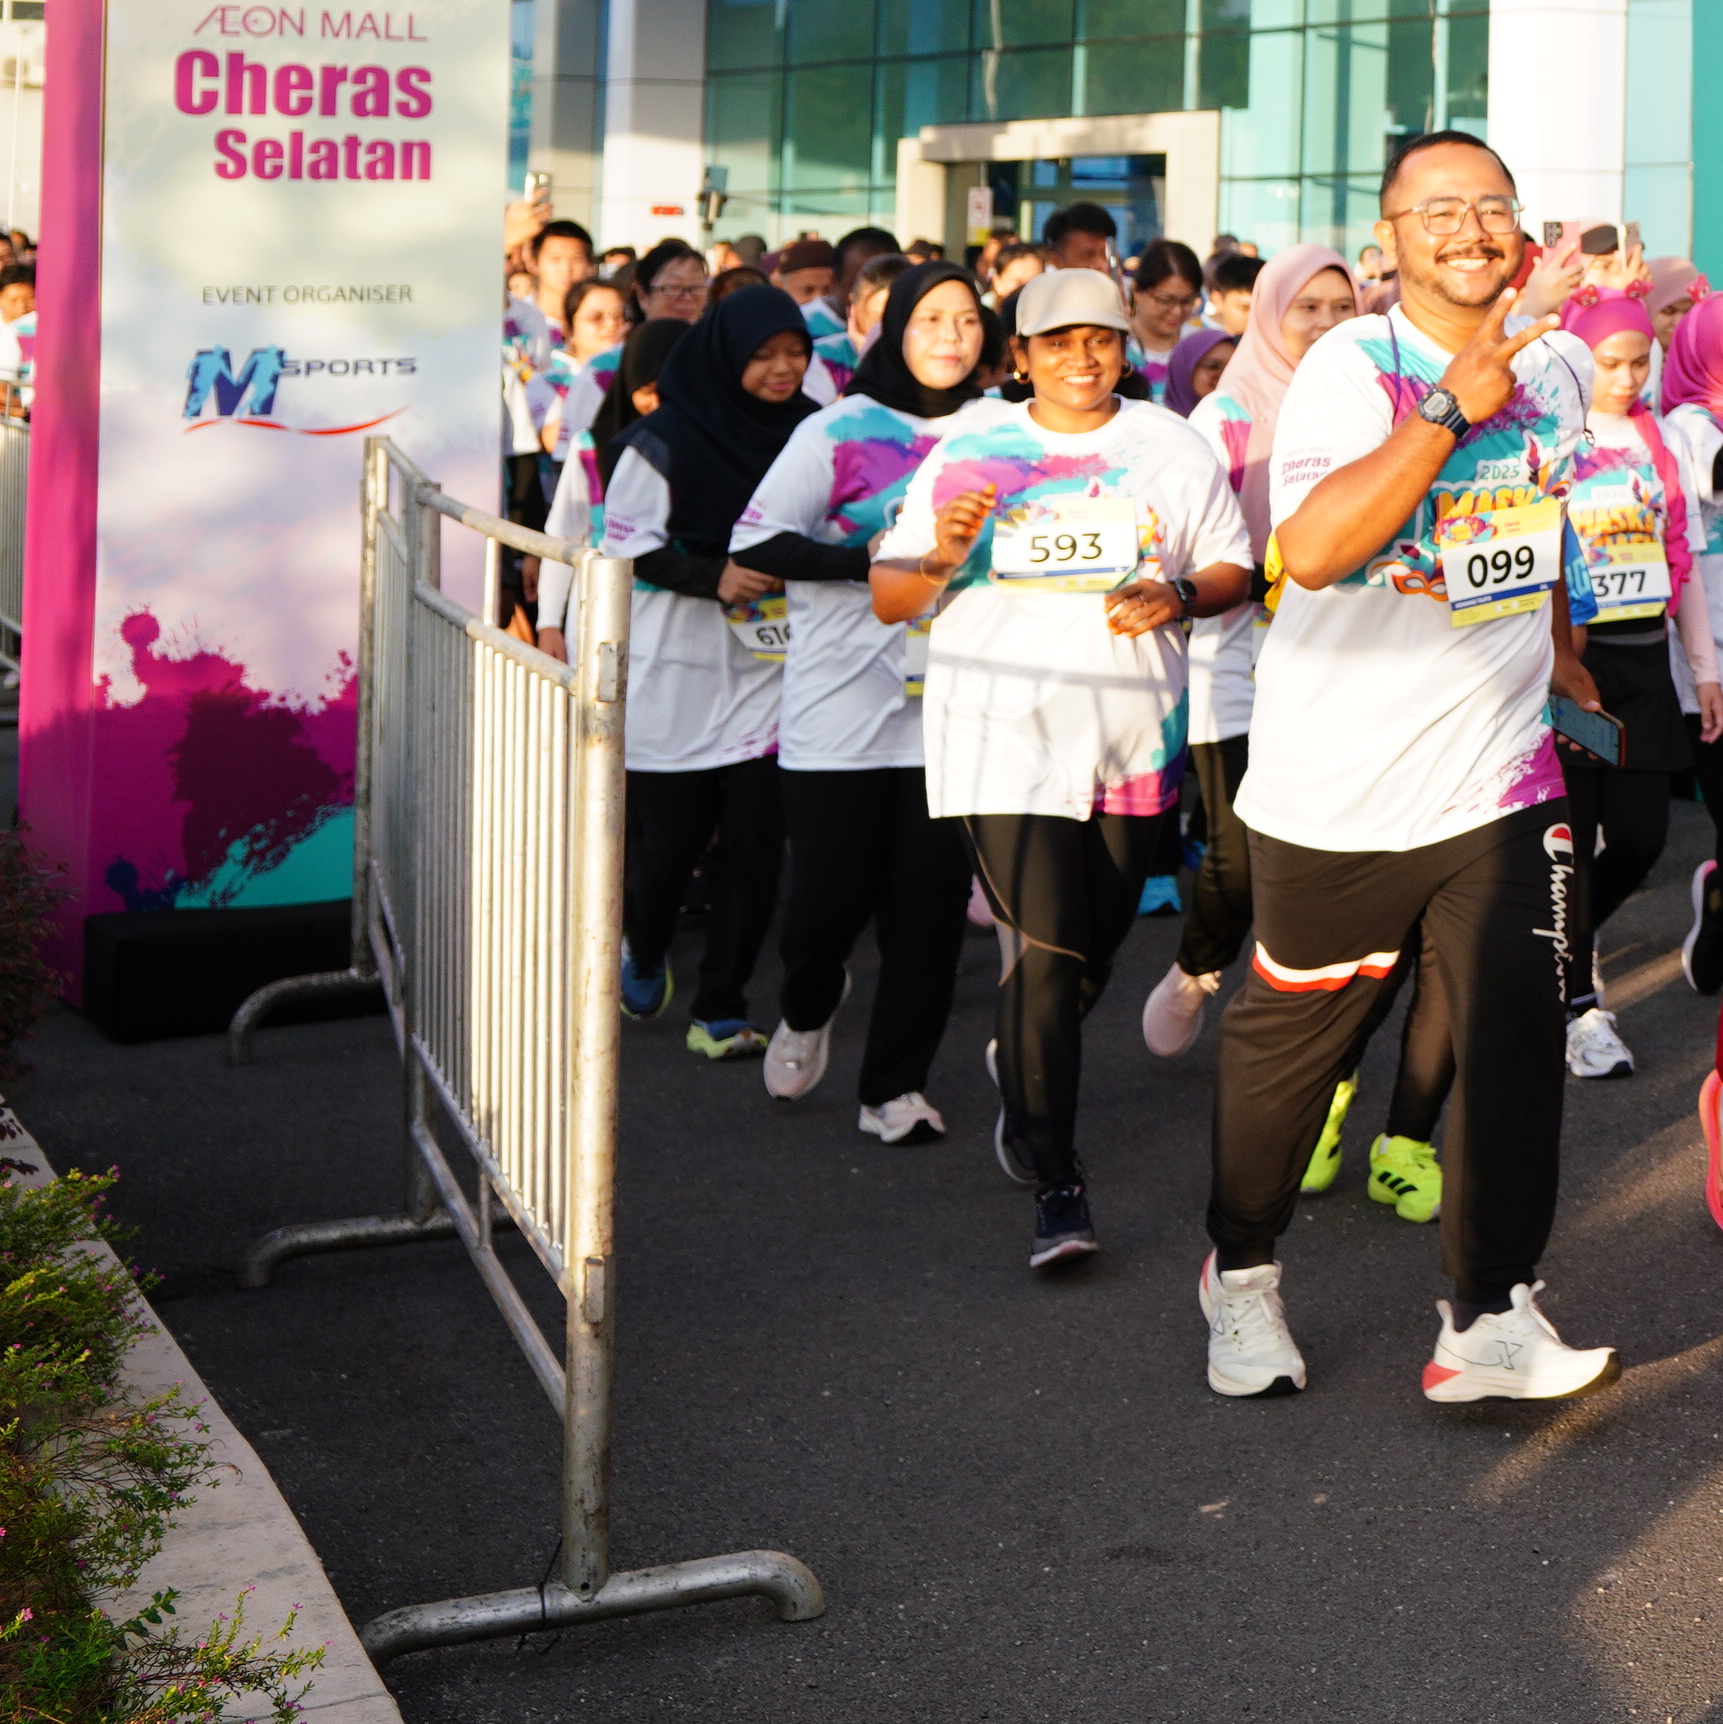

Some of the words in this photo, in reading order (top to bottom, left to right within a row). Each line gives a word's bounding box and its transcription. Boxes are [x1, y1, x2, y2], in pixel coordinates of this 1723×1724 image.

[320, 10, 429, 43] MALL
[173, 48, 434, 120] Cheras
[213, 127, 432, 181] Selatan
[201, 284, 276, 306] EVENT
[282, 283, 415, 305] ORGANISER
[1479, 463, 1521, 481] 2025
[1029, 532, 1103, 564] 593
[1466, 545, 1536, 589] 099
[1590, 570, 1647, 598] 377
